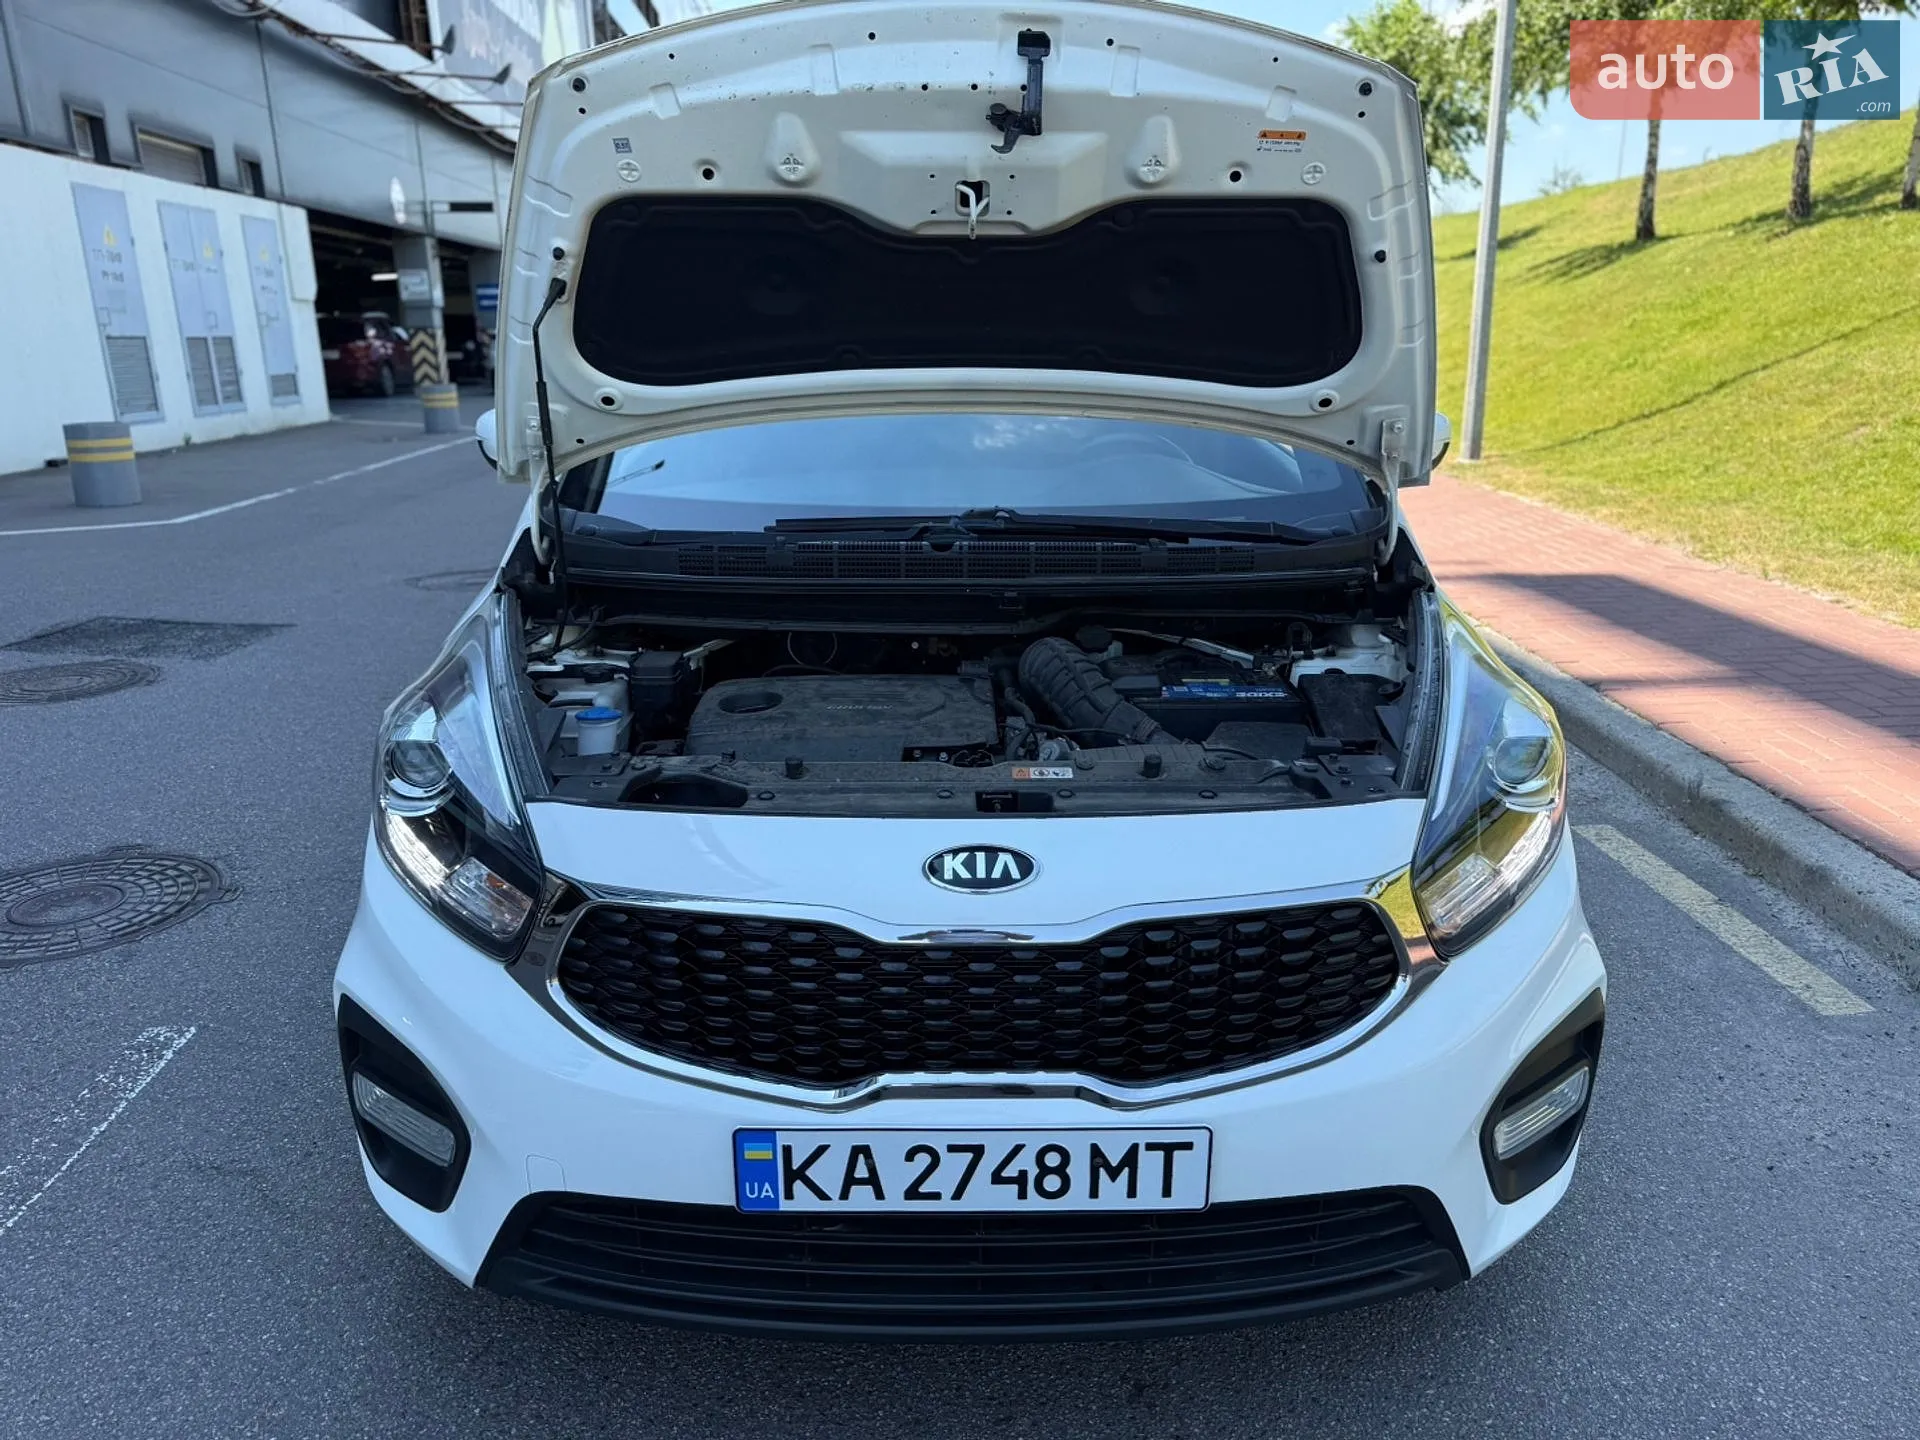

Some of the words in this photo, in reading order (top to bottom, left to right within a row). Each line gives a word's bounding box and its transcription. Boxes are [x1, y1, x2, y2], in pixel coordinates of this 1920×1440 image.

[942, 851, 1021, 879] KIA
[781, 1143, 885, 1200] KA
[903, 1143, 1071, 1200] 2748
[1088, 1141, 1194, 1199] MT
[745, 1182, 774, 1199] UA
